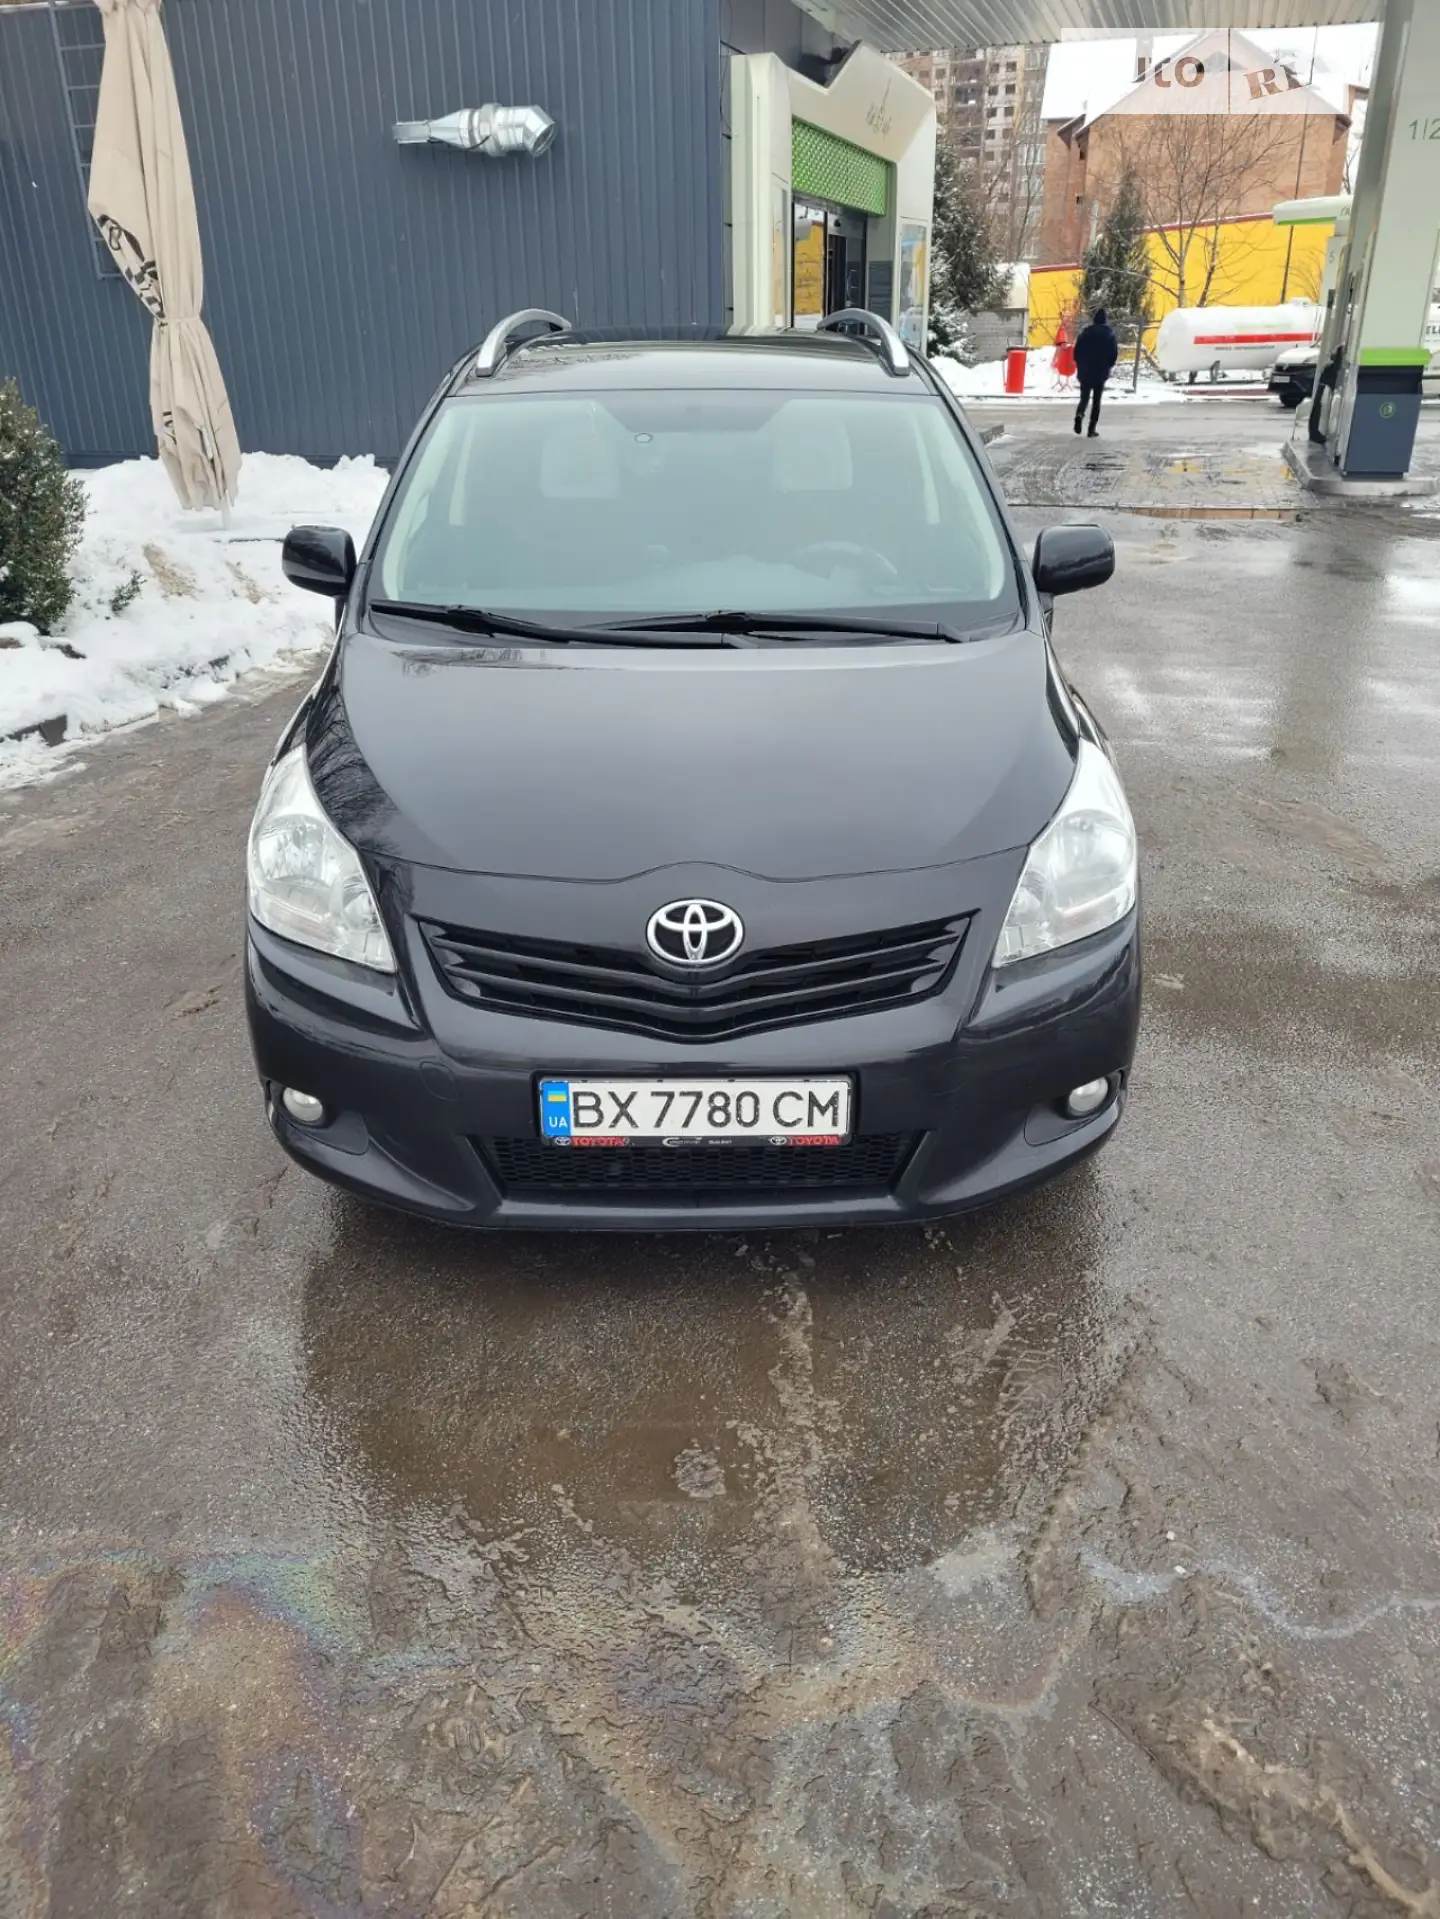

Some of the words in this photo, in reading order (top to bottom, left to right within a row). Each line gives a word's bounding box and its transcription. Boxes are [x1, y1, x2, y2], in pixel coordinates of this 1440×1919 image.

[549, 1116, 569, 1128] UA
[573, 1091, 638, 1128] BX
[650, 1091, 760, 1128] 7780
[773, 1091, 840, 1128] CM
[572, 1136, 625, 1146] TOYOTA
[788, 1135, 840, 1145] TOYOTA
